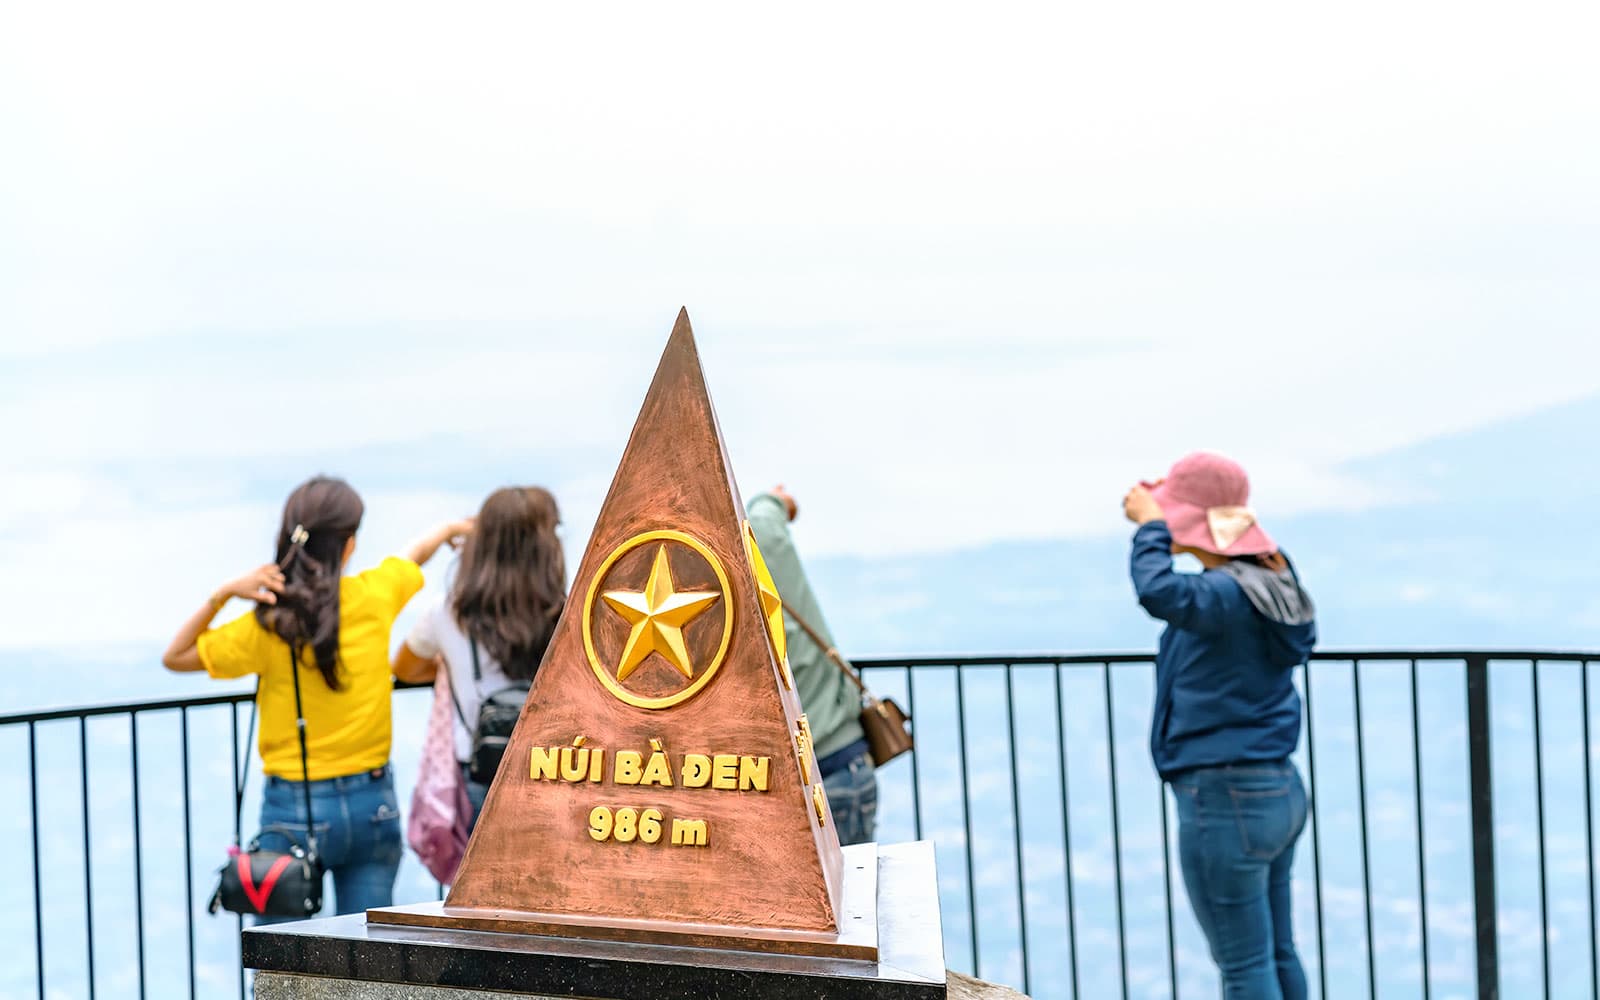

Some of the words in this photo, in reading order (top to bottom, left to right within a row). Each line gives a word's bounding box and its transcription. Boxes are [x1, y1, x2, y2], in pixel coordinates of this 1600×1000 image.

[530, 736, 604, 783] NÚI
[614, 738, 674, 787] BÀ
[681, 754, 771, 791] ĐEN
[588, 806, 664, 843] 986
[671, 818, 709, 847] m
